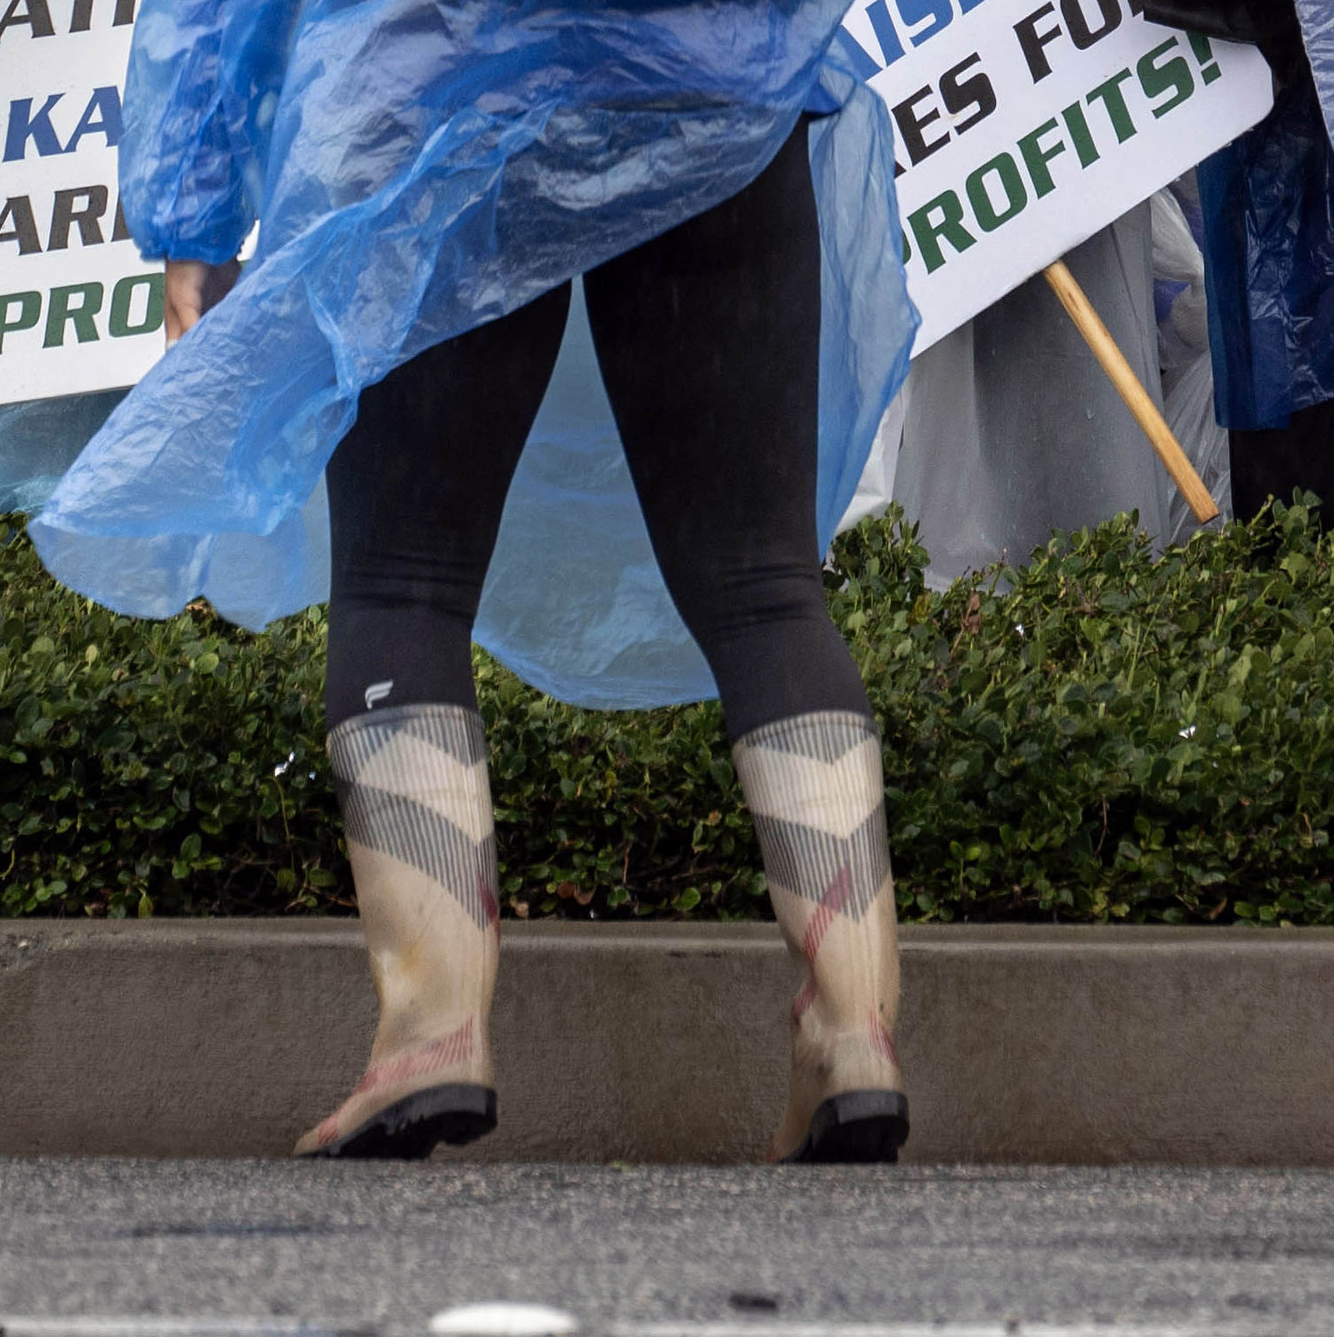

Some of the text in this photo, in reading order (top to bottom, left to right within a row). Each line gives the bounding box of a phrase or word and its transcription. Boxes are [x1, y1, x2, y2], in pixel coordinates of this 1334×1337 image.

[2, 86, 124, 162] KA
[892, 51, 997, 178] ES
[902, 32, 1222, 276] ROFITS!
